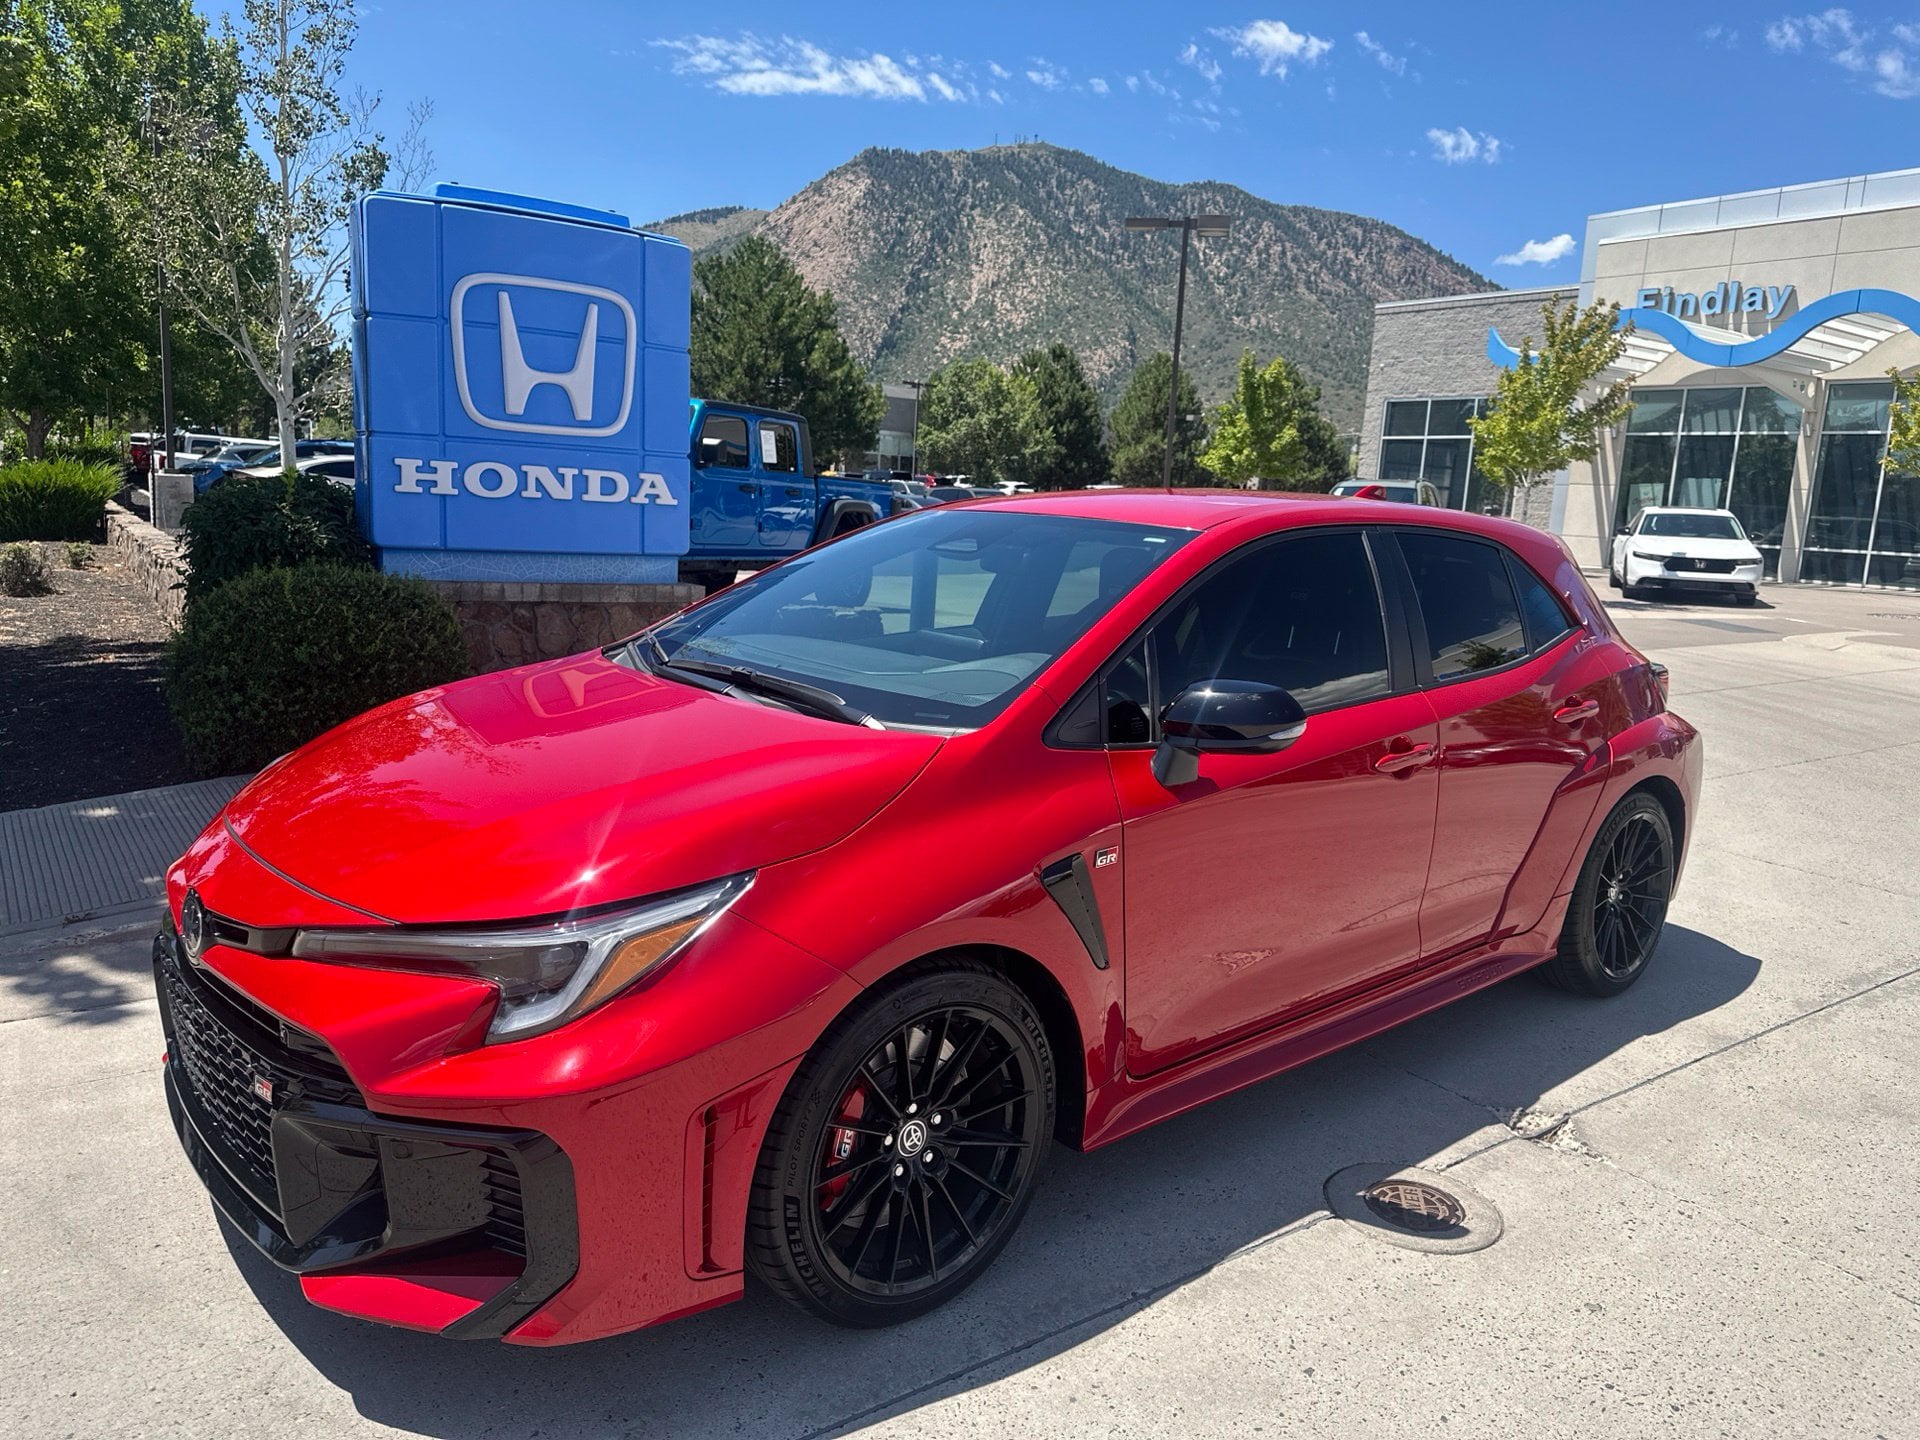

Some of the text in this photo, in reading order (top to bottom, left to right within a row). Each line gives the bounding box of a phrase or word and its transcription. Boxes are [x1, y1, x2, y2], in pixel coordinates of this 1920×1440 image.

[1636, 281, 1795, 320] Findlay
[393, 457, 679, 506] HONDA
[1097, 853, 1117, 866] GR
[1024, 1016, 1053, 1104] MICHELIN
[255, 1081, 272, 1101] GR
[787, 1155, 798, 1187] PILOT
[793, 1115, 810, 1152] SPORT
[840, 1129, 855, 1158] GR
[785, 1203, 830, 1297] MICHELIN
